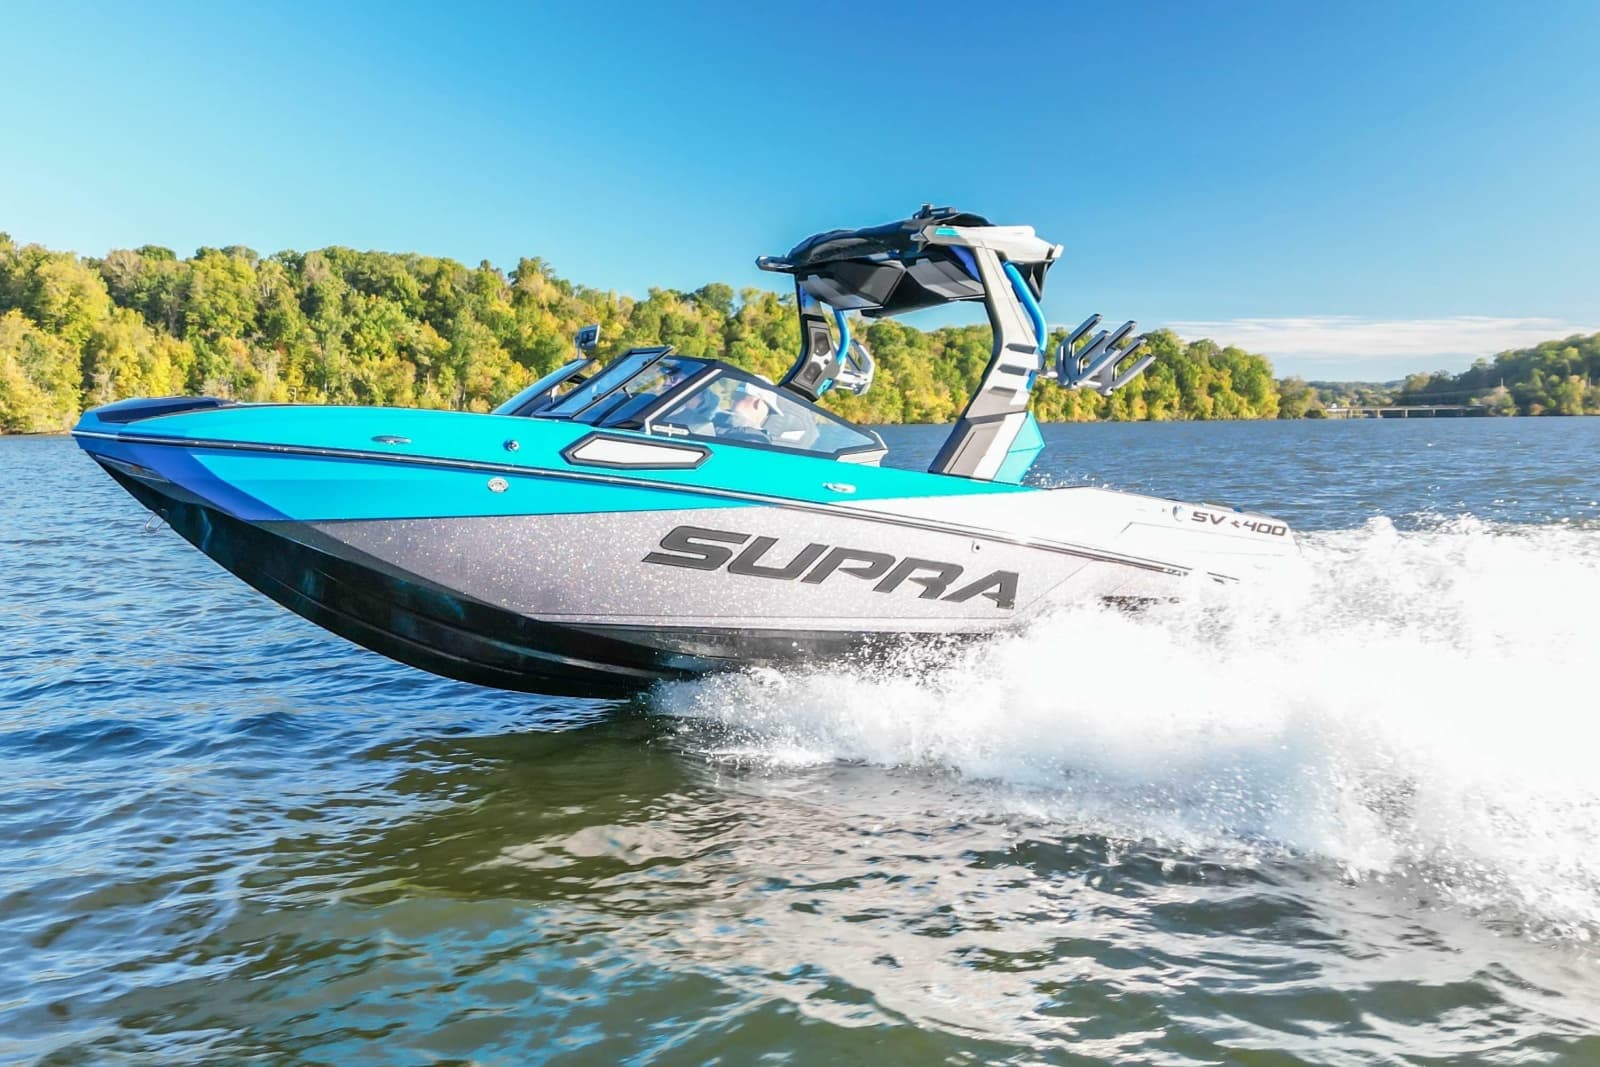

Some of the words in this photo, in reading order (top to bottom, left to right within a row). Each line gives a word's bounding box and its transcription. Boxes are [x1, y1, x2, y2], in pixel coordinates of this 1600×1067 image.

[1191, 511, 1227, 525] SV
[1243, 520, 1287, 536] 400
[641, 525, 1019, 608] SUPRA
